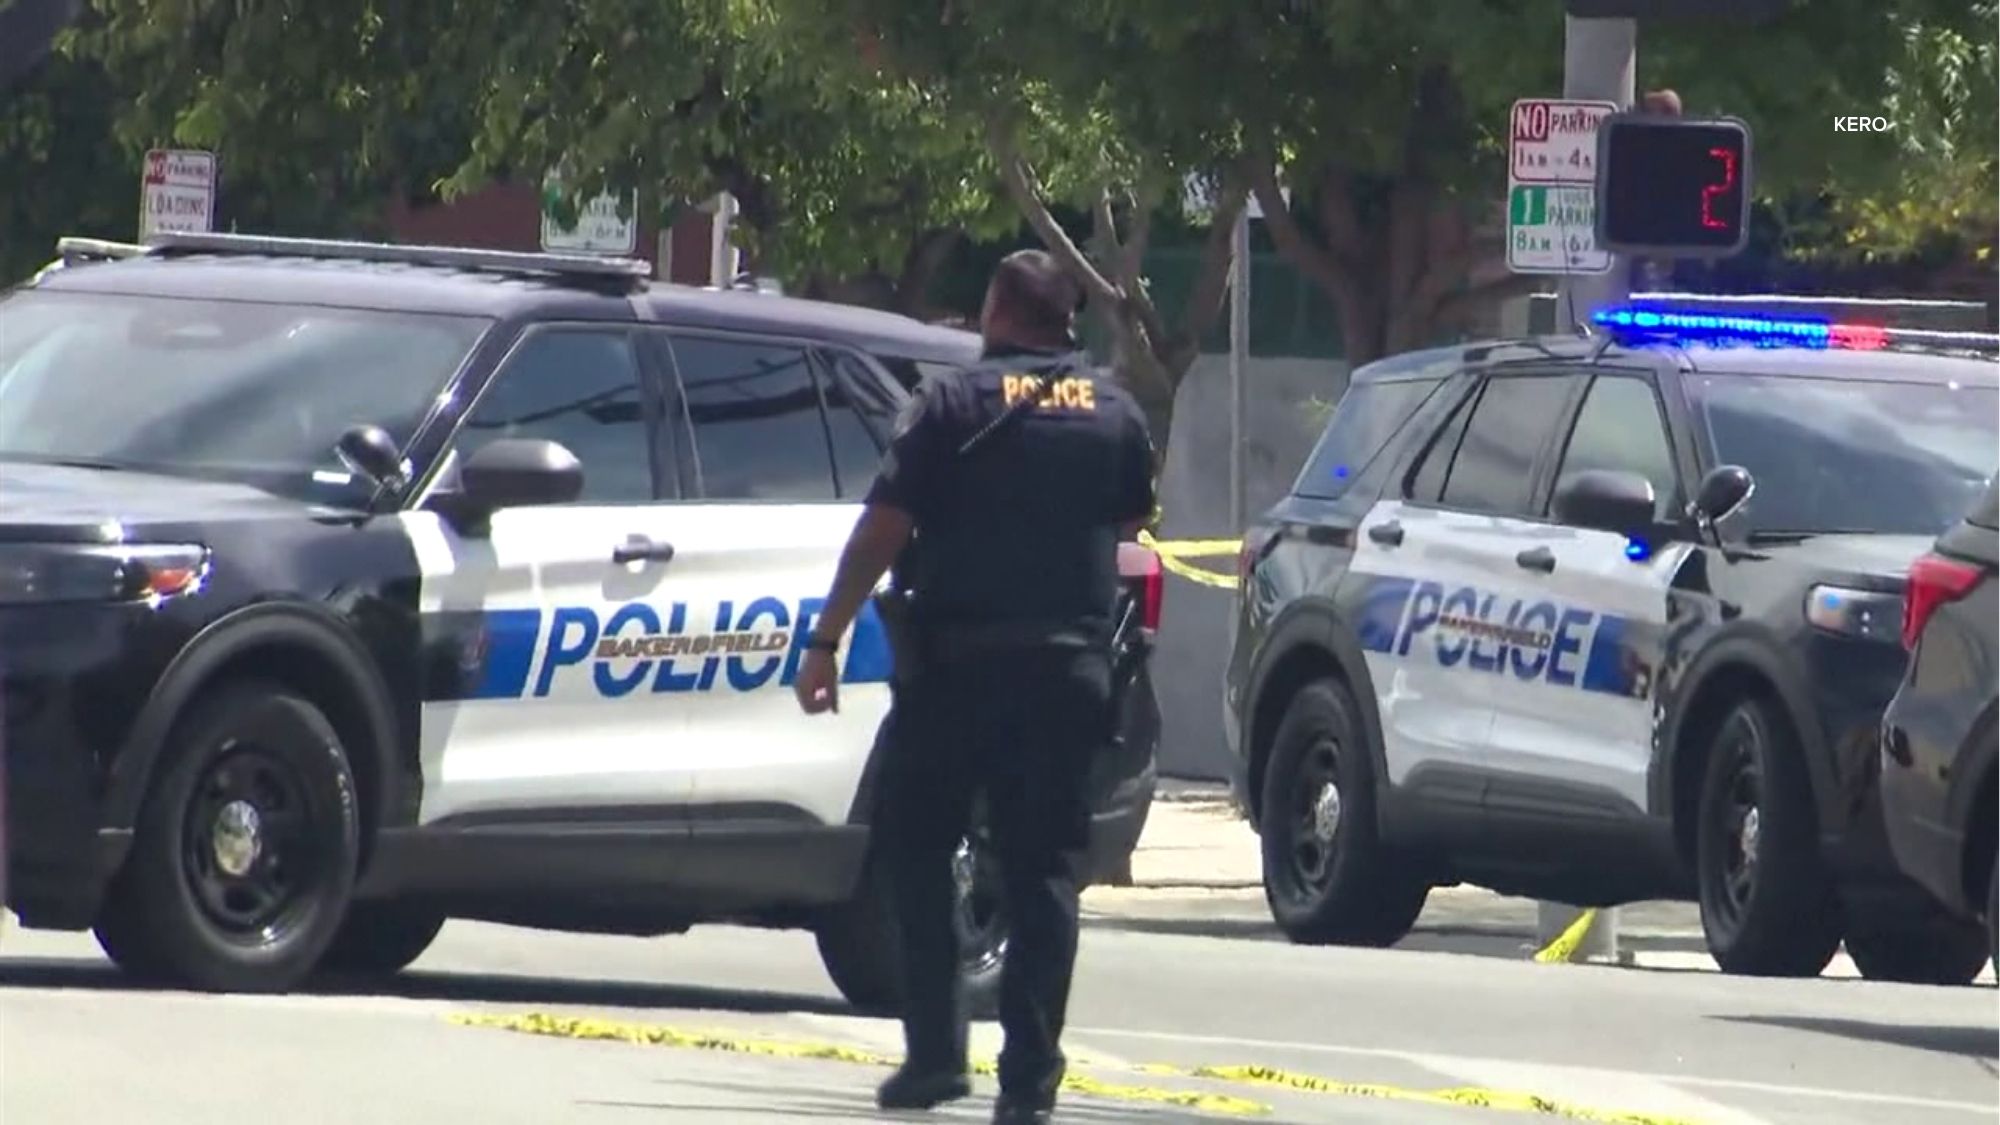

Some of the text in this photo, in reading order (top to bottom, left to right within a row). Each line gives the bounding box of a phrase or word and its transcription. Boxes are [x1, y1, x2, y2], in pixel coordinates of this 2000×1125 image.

[1516, 105, 1600, 138] NO PARKIN
[1569, 147, 1592, 169] 4A
[1702, 147, 1737, 228] 2
[1523, 188, 1532, 223] 1
[1398, 580, 1593, 687] POLICE
